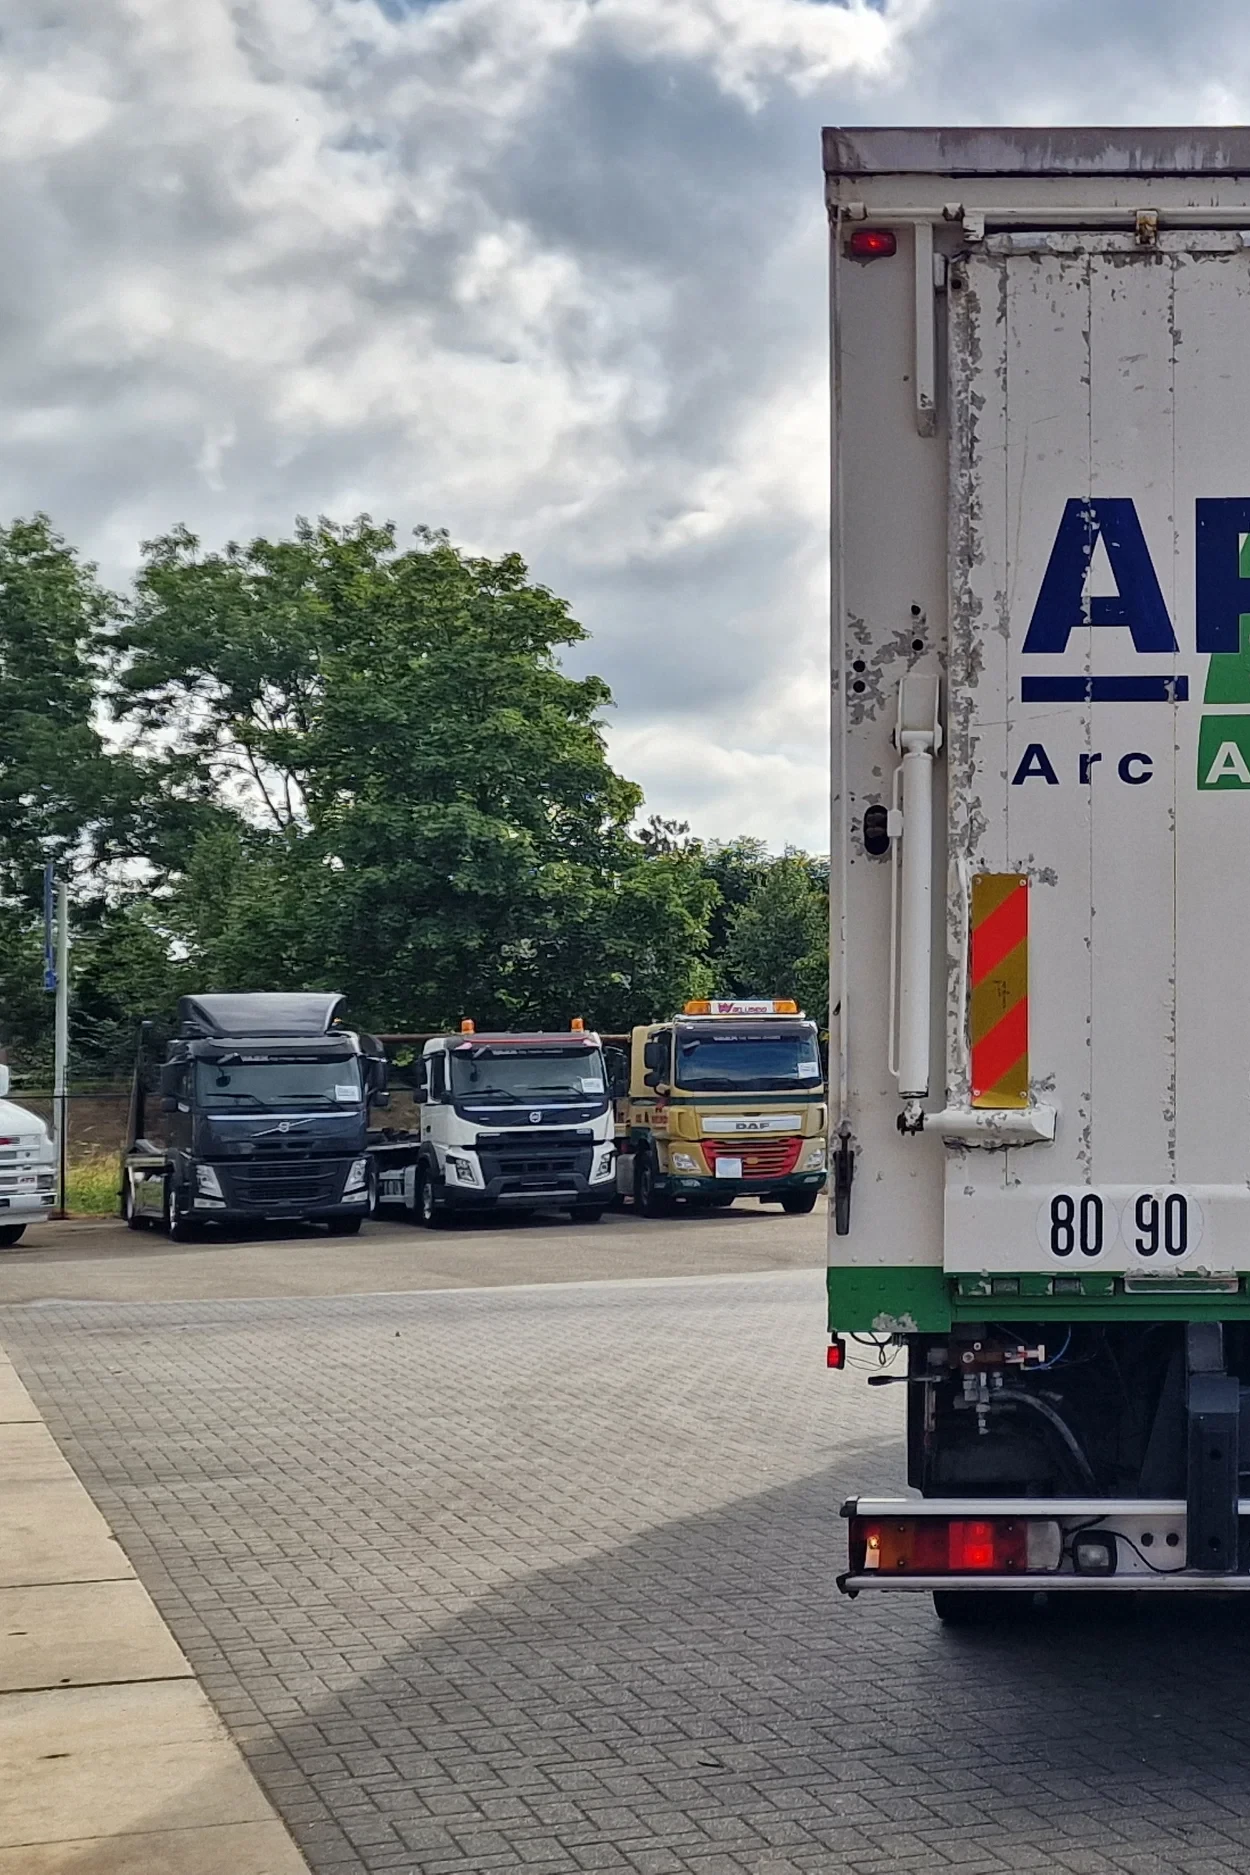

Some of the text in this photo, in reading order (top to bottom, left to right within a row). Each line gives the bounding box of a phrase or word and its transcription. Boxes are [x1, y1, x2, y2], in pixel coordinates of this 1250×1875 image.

[1011, 742, 1155, 786] Arc
[735, 1122, 770, 1130] DAF
[1050, 1193, 1188, 1257] 80 90
